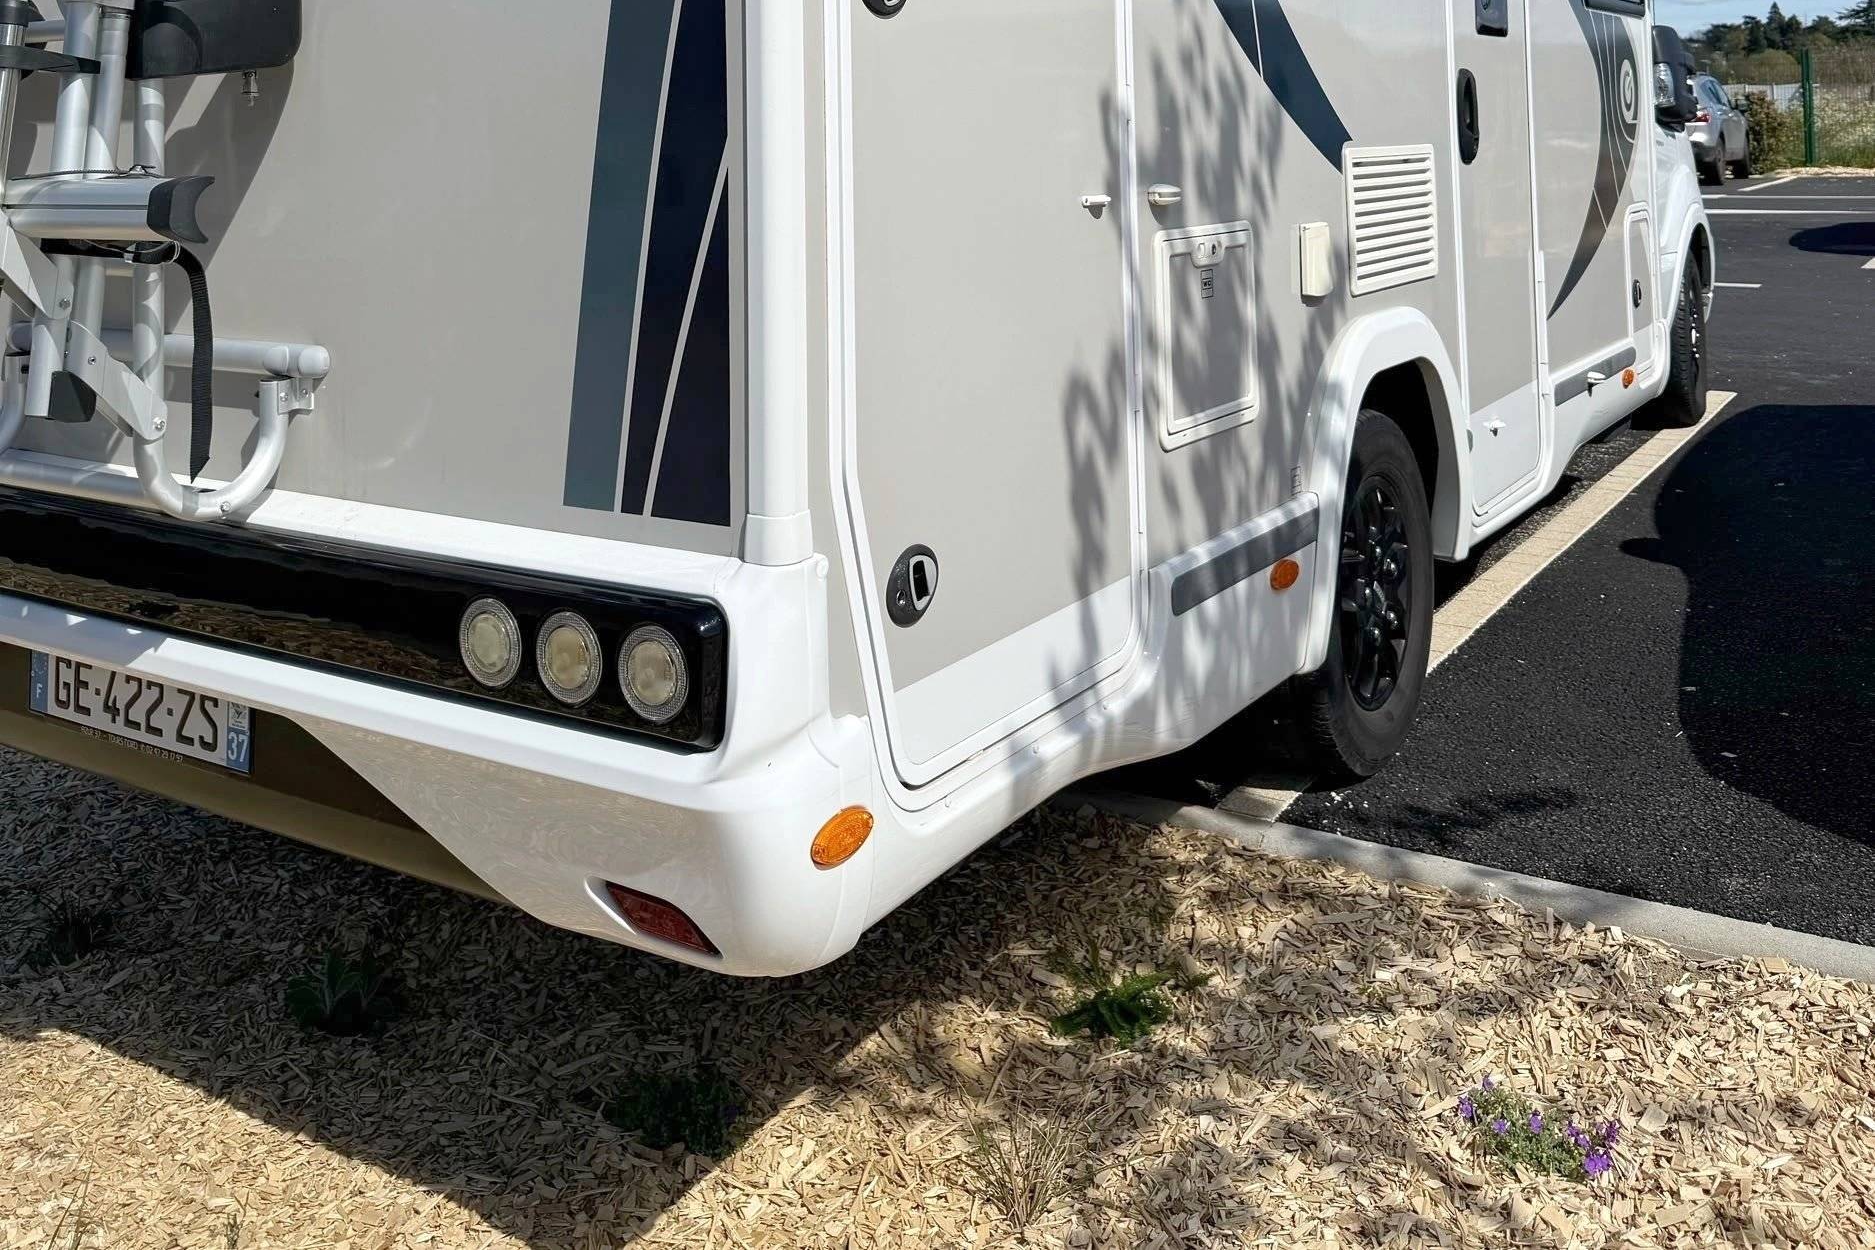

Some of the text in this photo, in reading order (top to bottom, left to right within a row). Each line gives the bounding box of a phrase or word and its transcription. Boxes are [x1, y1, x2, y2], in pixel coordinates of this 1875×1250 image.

[36, 683, 43, 698] F
[54, 655, 219, 753] GE-422-ZS
[228, 731, 249, 763] 37
